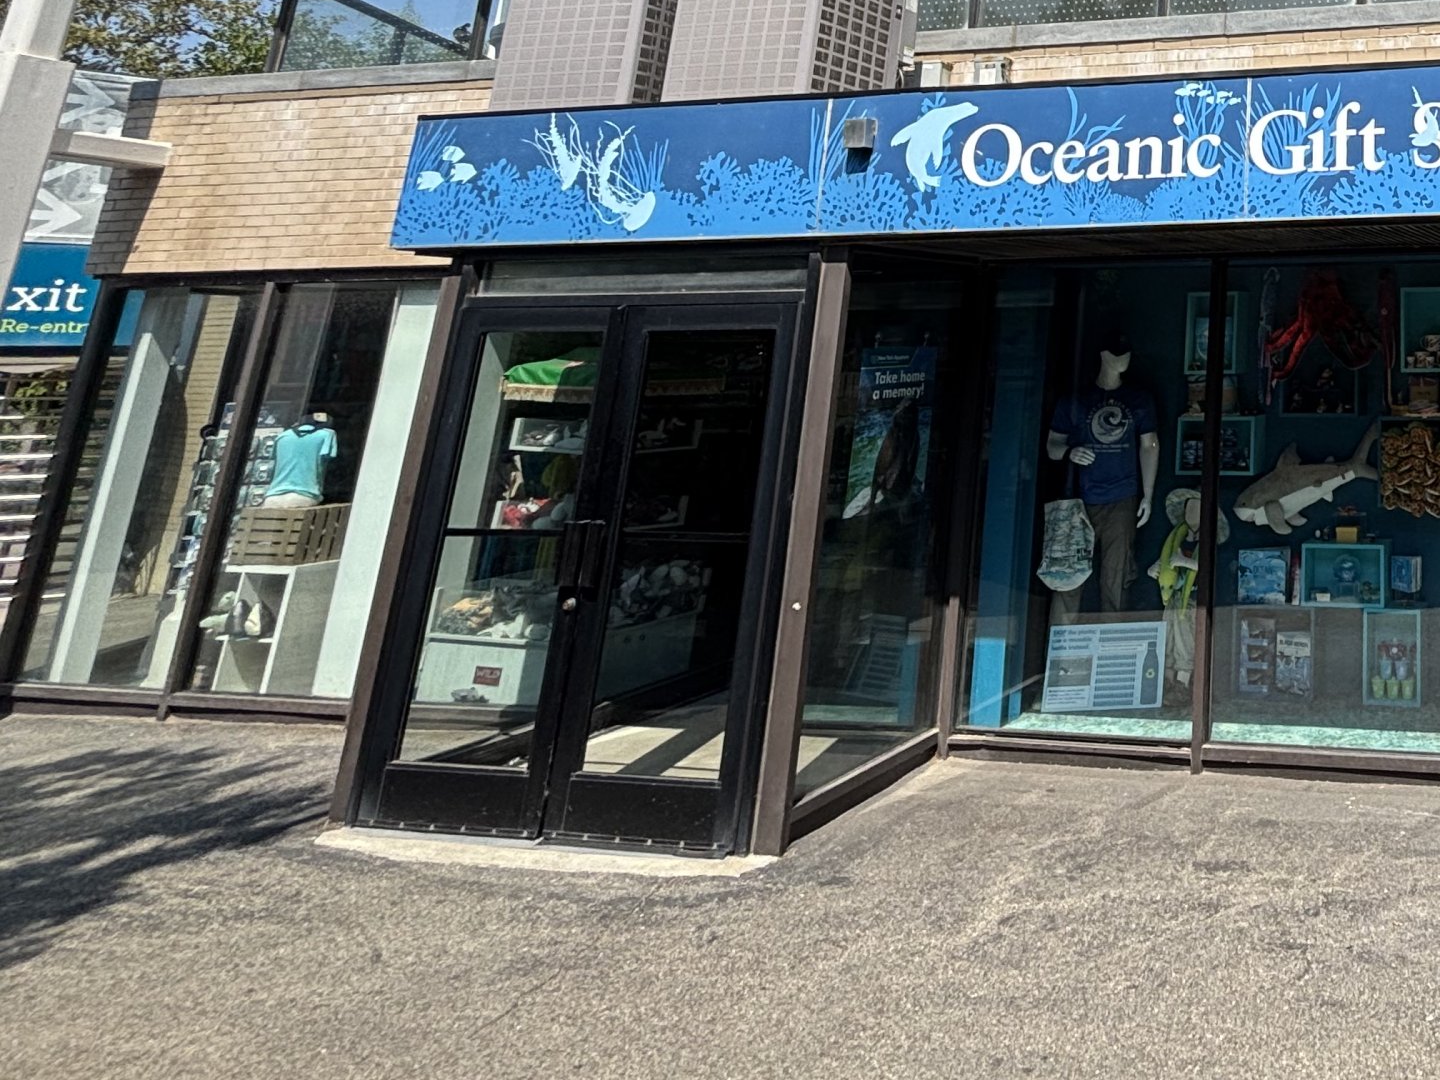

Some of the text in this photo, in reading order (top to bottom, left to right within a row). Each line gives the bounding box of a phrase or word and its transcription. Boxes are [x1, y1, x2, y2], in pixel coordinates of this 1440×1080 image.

[961, 113, 1221, 188] Oceanic
[1249, 102, 1385, 176] Gift
[6, 278, 88, 312] xit
[0, 319, 90, 333] Re-entr
[875, 369, 926, 385] Take home
[872, 382, 925, 400] a memory!
